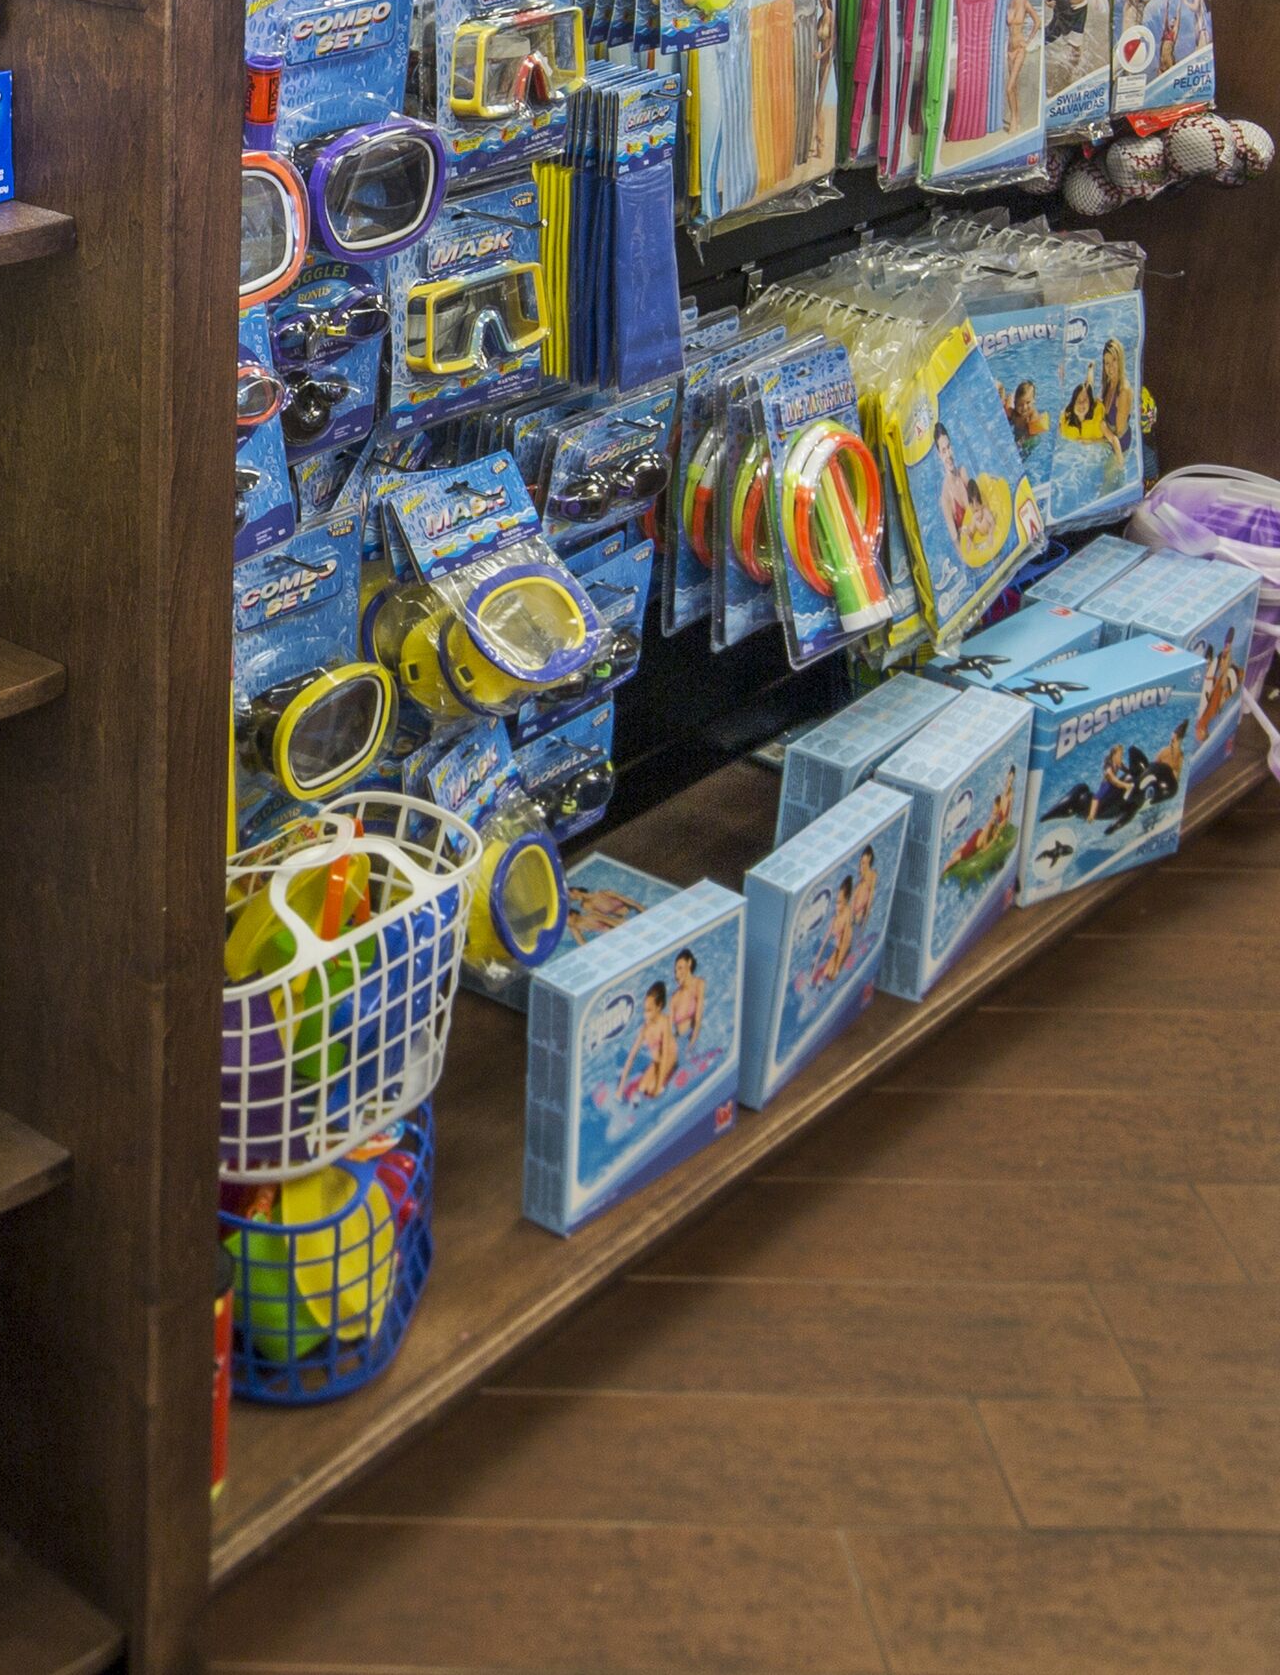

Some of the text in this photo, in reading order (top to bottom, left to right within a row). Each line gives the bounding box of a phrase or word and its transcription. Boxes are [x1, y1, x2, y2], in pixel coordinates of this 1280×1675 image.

[293, 1, 392, 41] COMBO
[315, 26, 370, 56] SET
[1173, 74, 1212, 88] PELOTA
[1187, 65, 1211, 76] BALL
[1049, 99, 1105, 118] SALVAVIDAS
[1056, 87, 1105, 107] SWIM RING
[431, 229, 513, 267] MASK
[977, 322, 1058, 358] estway
[265, 583, 317, 617] SET
[1055, 685, 1173, 761] Bestway
